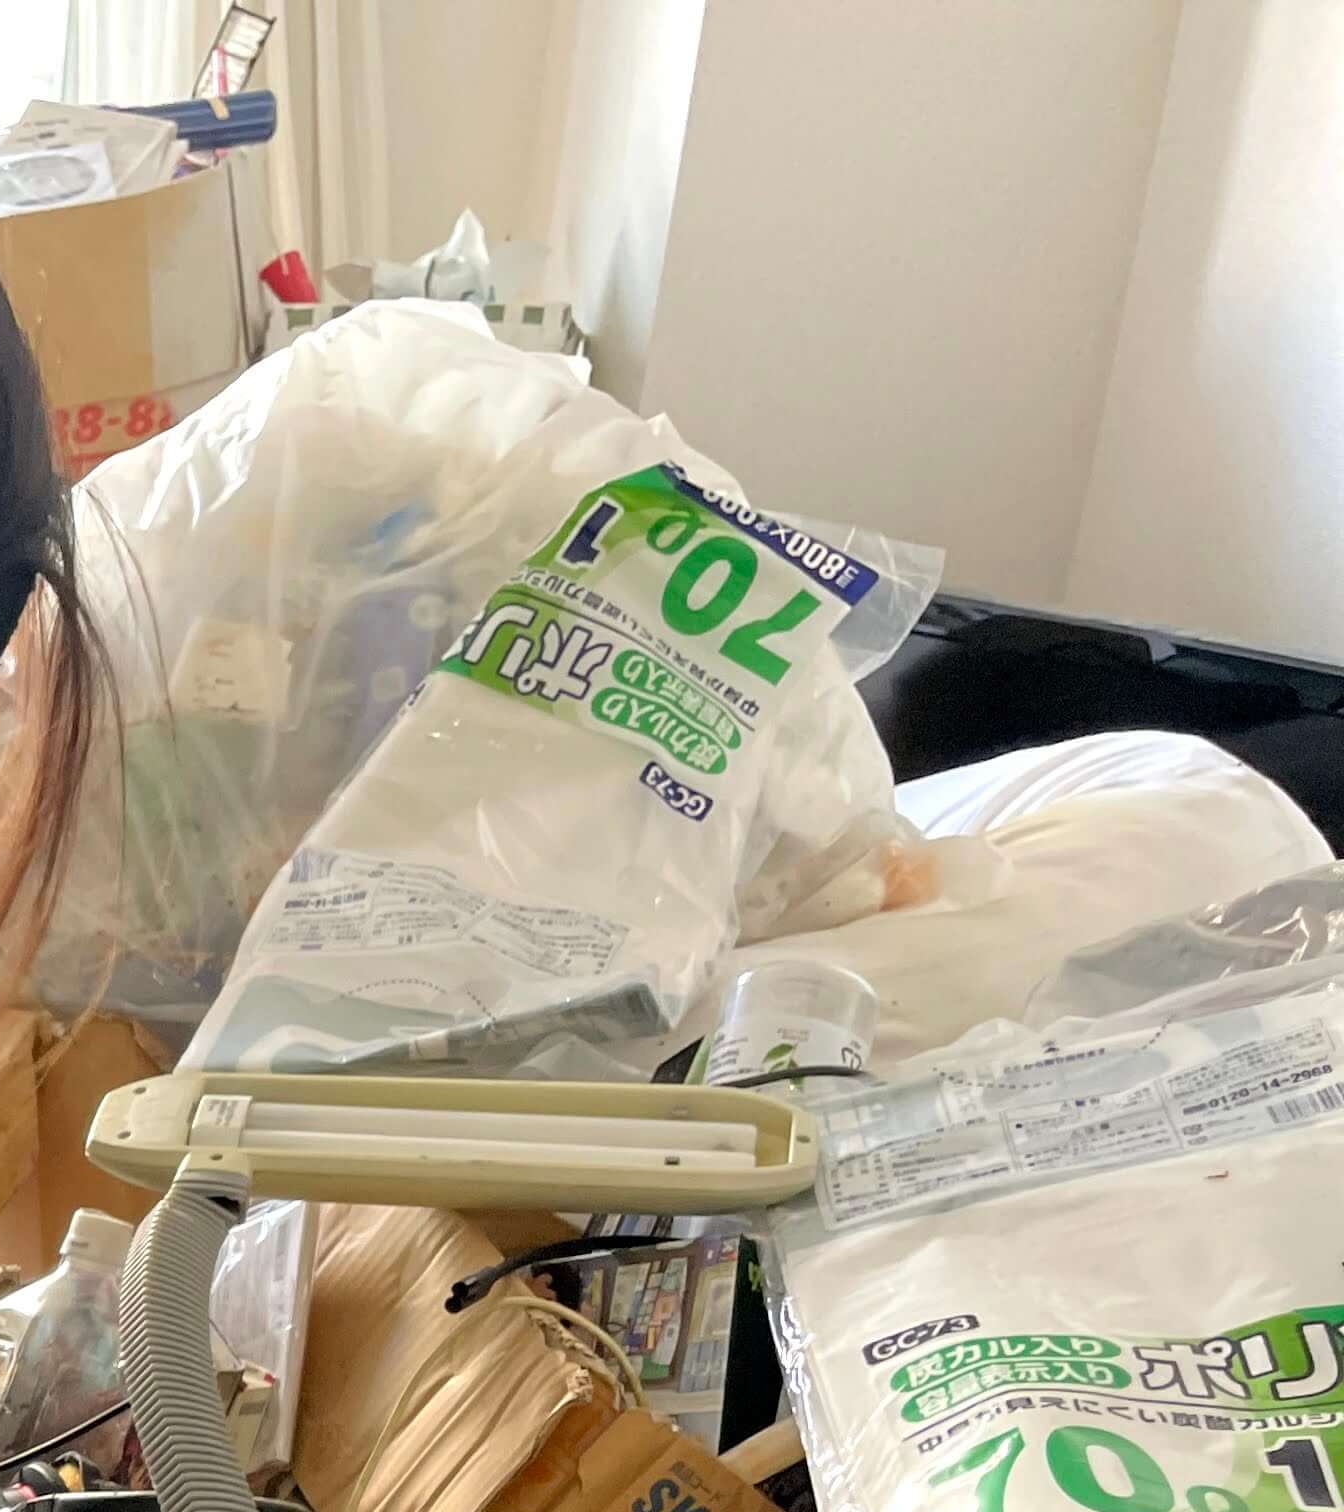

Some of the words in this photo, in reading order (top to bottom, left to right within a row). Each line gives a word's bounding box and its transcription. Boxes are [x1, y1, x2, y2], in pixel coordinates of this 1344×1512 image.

[645, 766, 709, 818] GC-73
[870, 1316, 972, 1361] GC-73
[905, 1336, 1105, 1388] 炭カル入り
